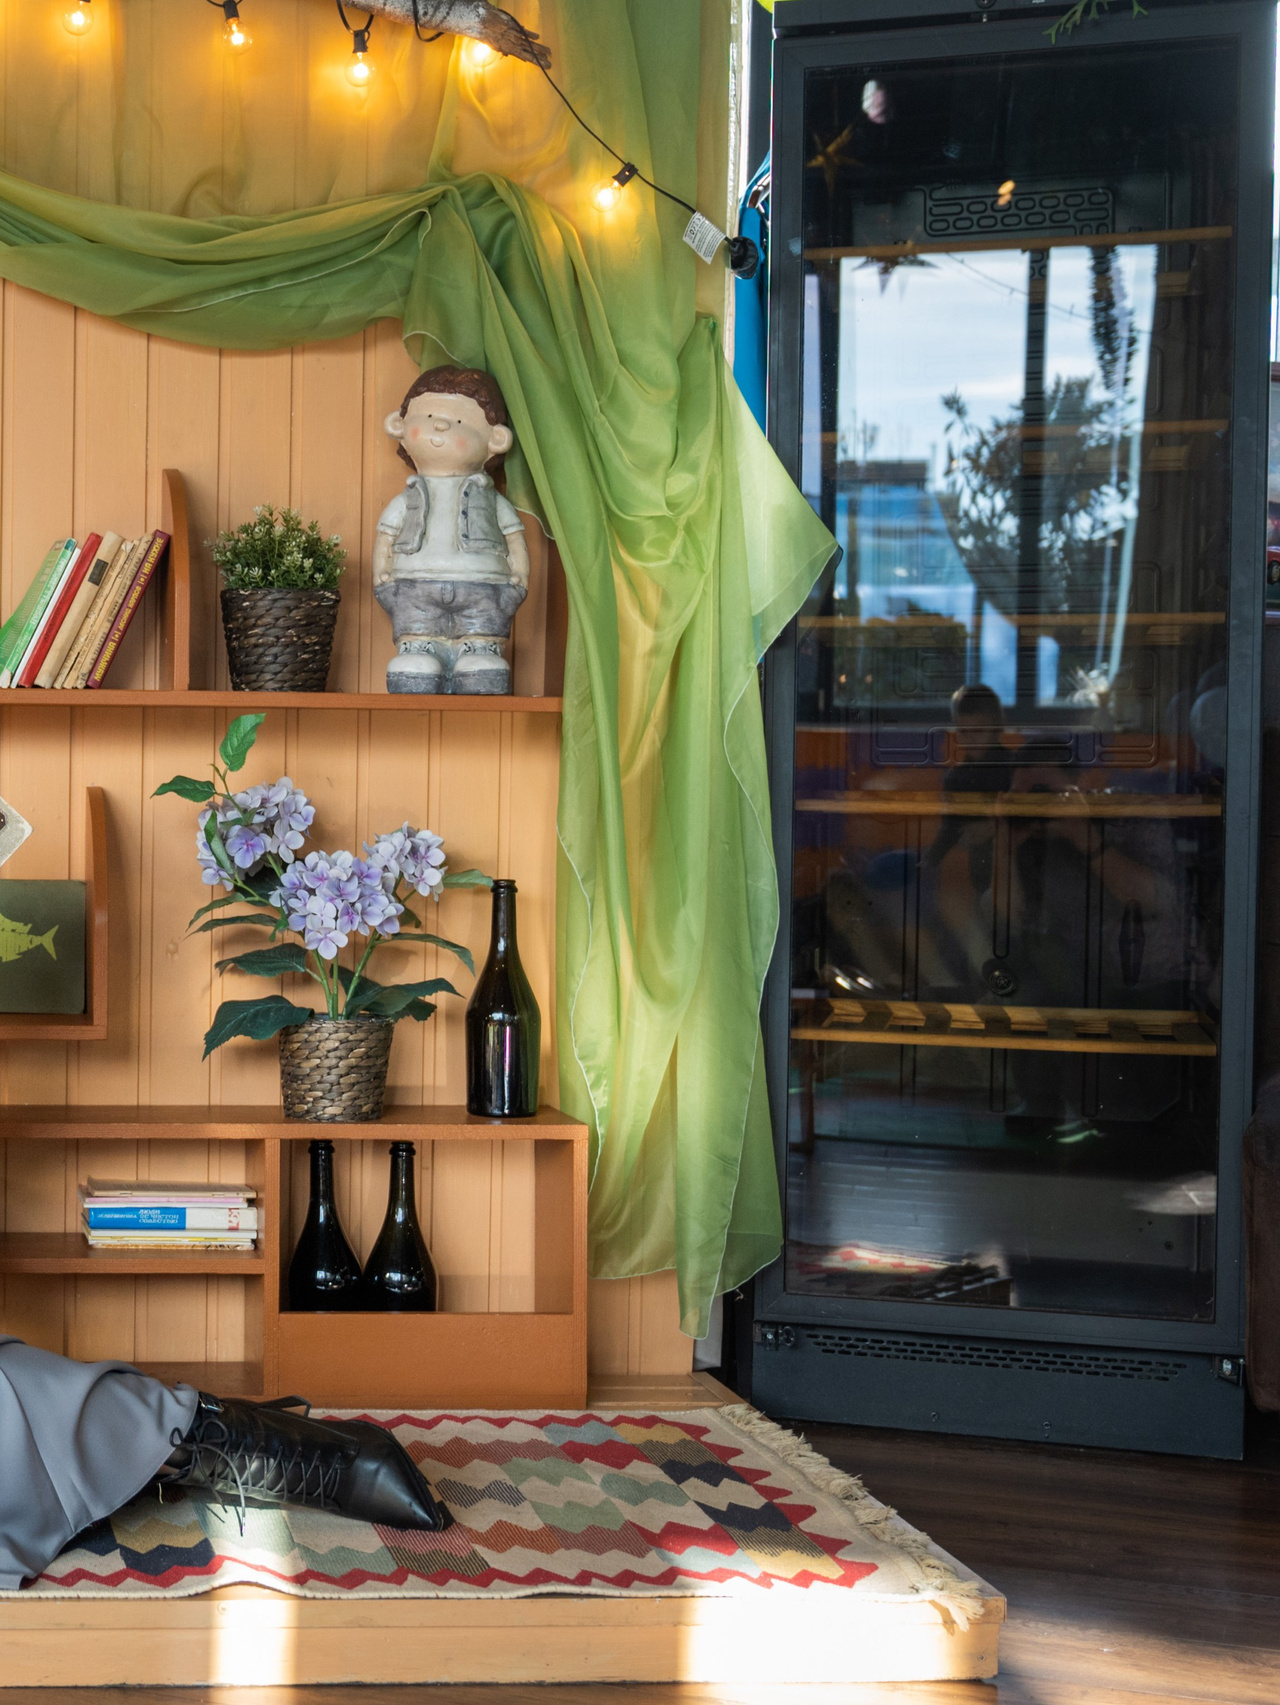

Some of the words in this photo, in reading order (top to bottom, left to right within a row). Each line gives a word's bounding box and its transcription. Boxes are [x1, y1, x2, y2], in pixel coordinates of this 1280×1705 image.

[146, 537, 164, 564] КУХНЕ
[141, 561, 153, 574] НА
[93, 641, 116, 681] МУЖЧИНА
